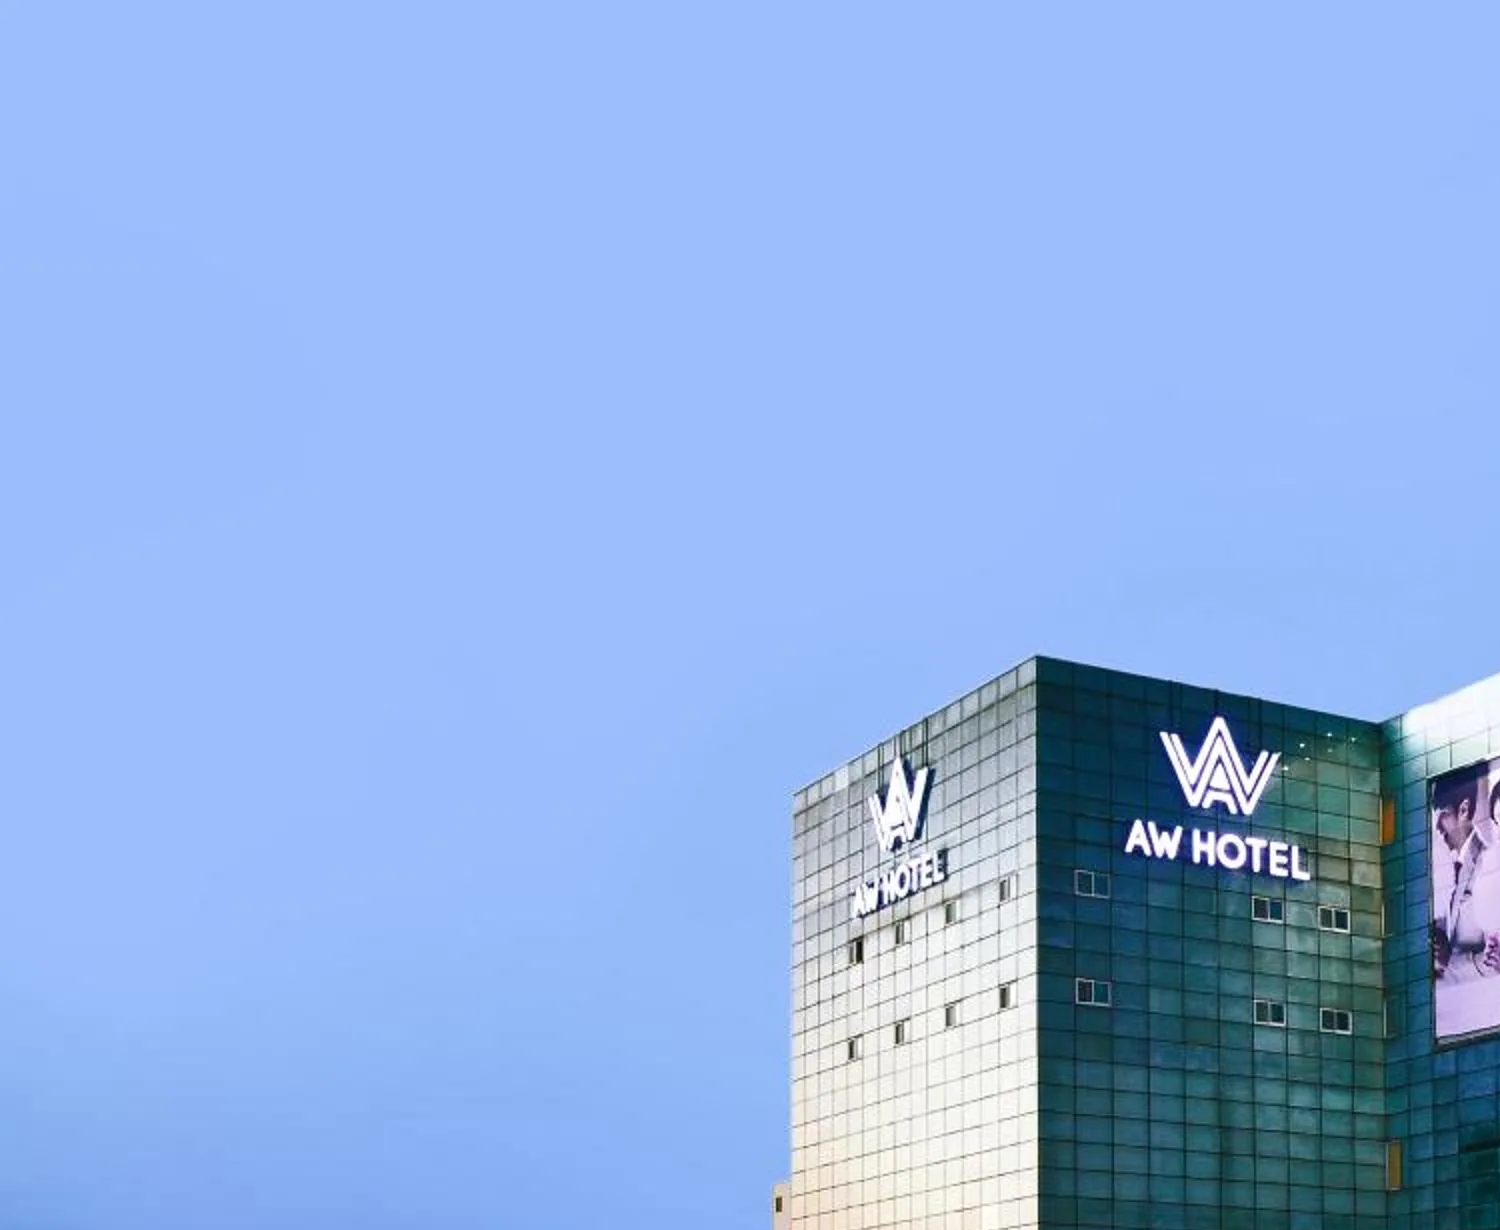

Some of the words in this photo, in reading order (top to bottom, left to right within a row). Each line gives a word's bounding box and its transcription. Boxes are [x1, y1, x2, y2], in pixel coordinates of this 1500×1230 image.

[852, 877, 880, 918] AW
[882, 848, 946, 906] HOTEL
[1124, 818, 1183, 861] AW
[1191, 827, 1311, 882] HOTEL
